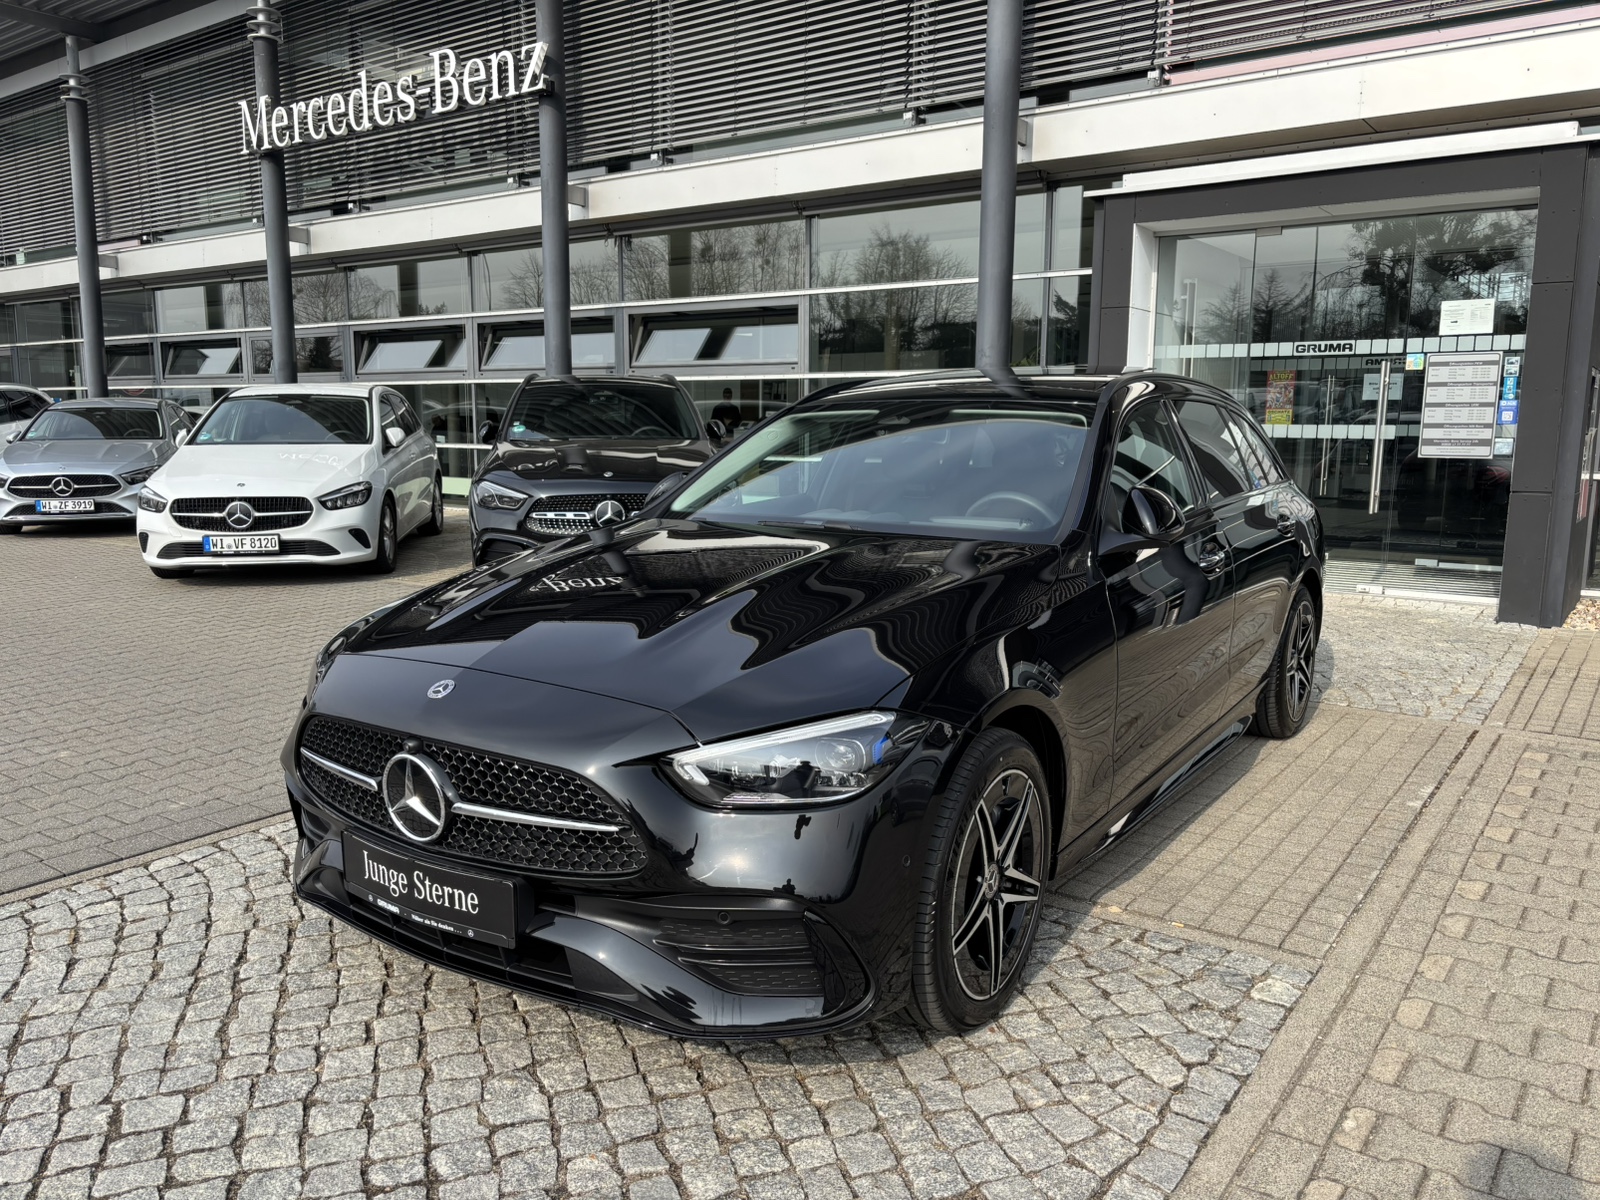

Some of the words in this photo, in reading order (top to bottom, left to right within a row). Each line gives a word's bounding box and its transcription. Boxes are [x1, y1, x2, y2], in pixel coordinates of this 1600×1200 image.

[238, 41, 549, 155] Mercedes-Benz
[1295, 343, 1353, 353] GRUMA
[1269, 373, 1294, 381] ALTOFF
[41, 501, 52, 510] WI
[58, 501, 69, 510] ZF
[71, 500, 93, 509] 3919
[211, 538, 225, 550] WI
[233, 538, 247, 549] VF
[249, 537, 277, 549] 8120
[362, 850, 408, 897] Junge
[413, 870, 479, 915] Sterne
